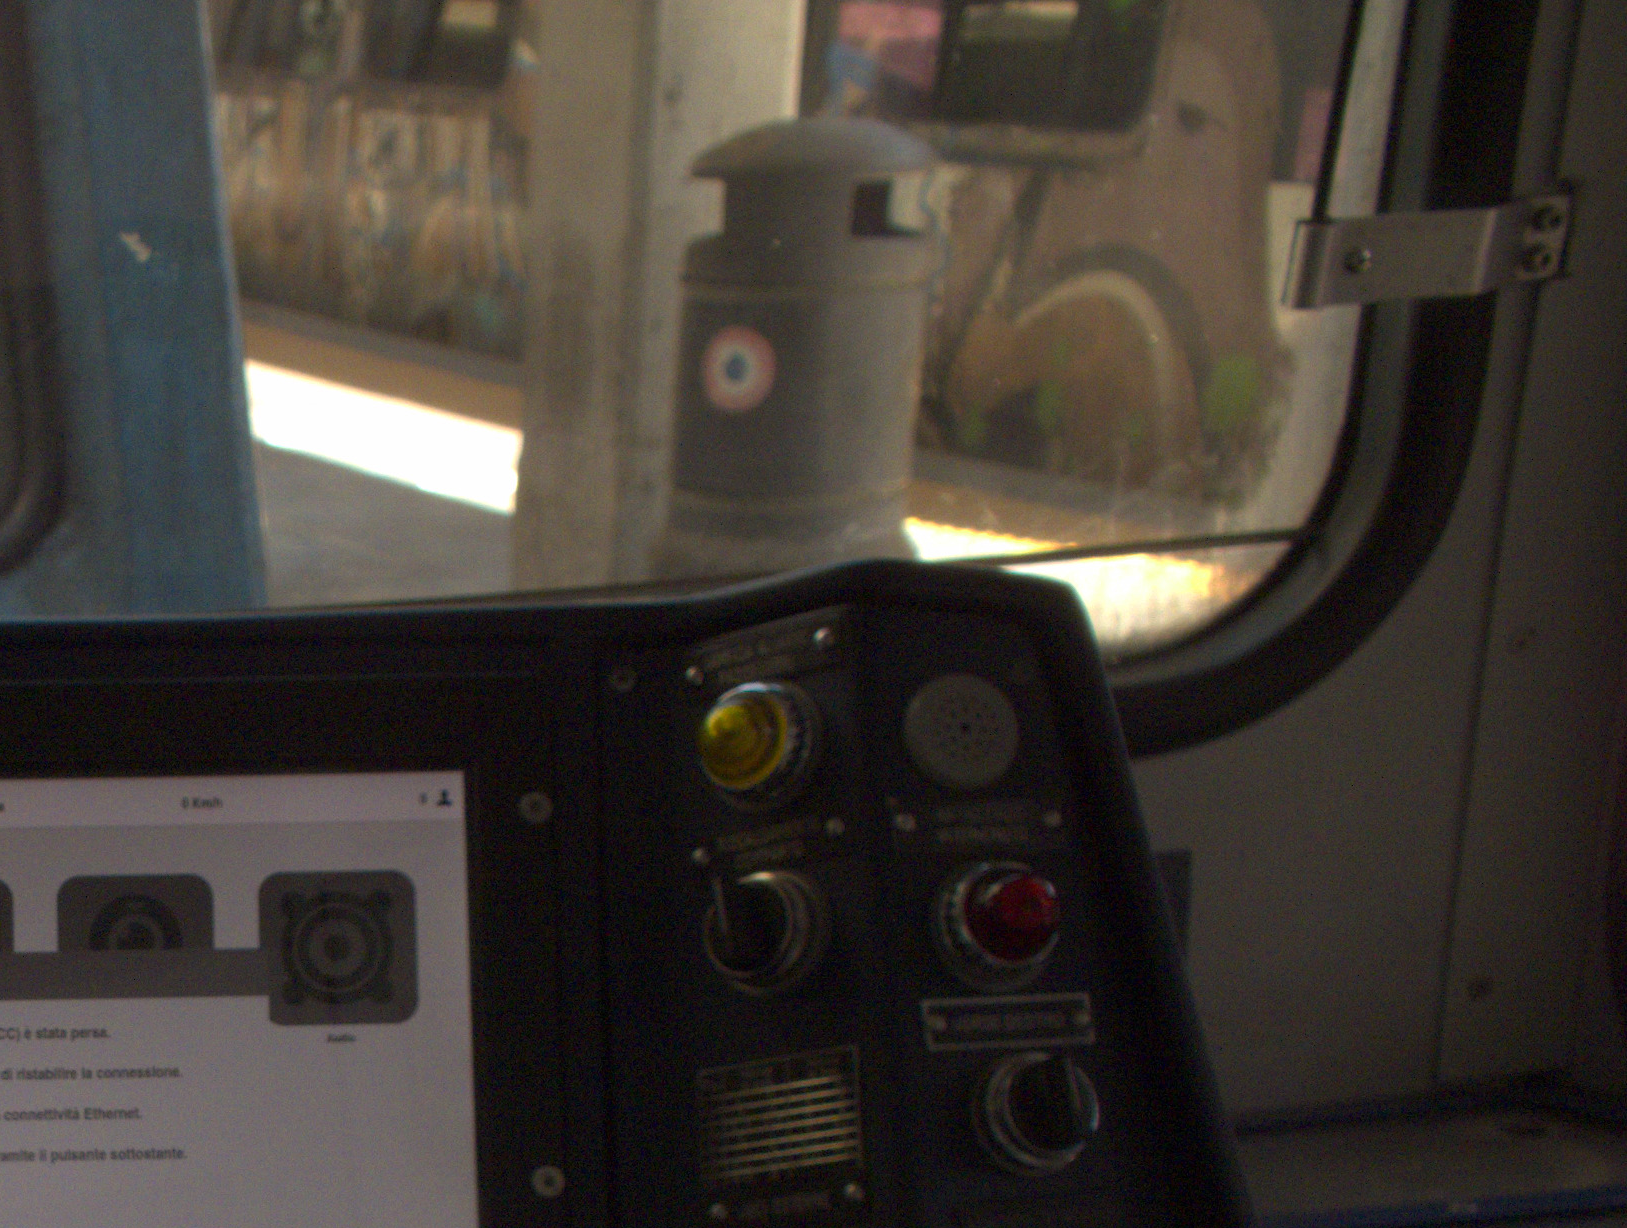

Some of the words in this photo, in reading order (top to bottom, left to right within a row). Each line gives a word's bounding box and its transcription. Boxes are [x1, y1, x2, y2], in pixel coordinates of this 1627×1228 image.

[35, 1028, 67, 1039] stata
[71, 1029, 111, 1041] persa.
[16, 1068, 78, 1080] ristabilire
[96, 1067, 183, 1079] connessione.
[84, 1108, 142, 1120] Ethernet.
[51, 1149, 106, 1163] pulsante
[110, 1148, 188, 1160] sottostante.
